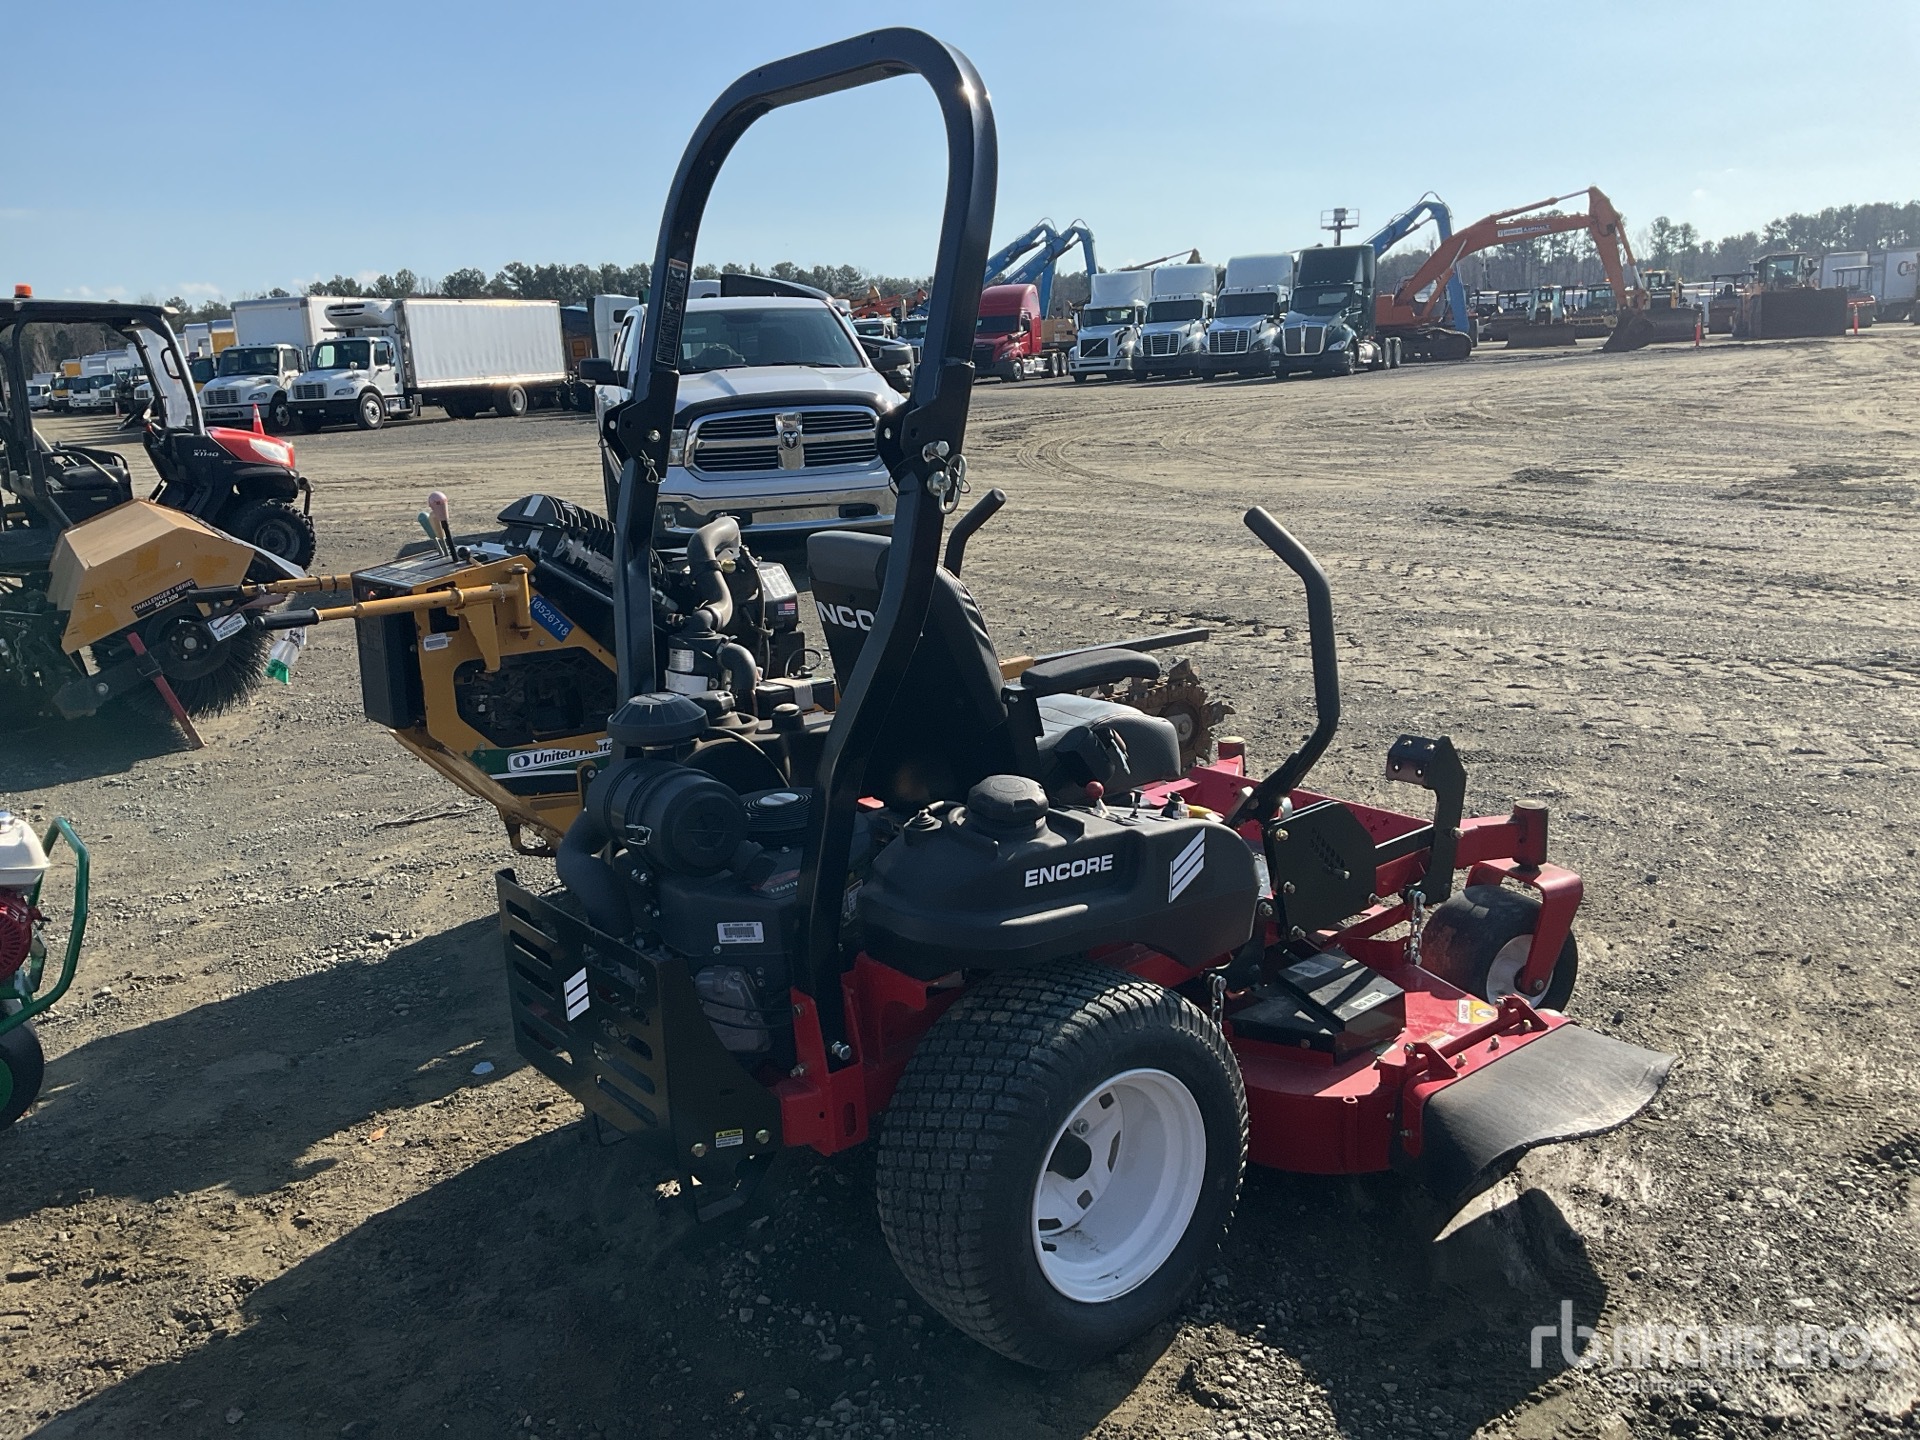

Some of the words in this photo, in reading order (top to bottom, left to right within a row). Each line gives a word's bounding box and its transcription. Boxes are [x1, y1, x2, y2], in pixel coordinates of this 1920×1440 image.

[1897, 261, 1917, 277] CEN
[132, 589, 171, 612] CHALLENGER
[175, 580, 195, 592] SERIES
[154, 598, 168, 609] SCM
[168, 593, 179, 603] 200
[530, 596, 569, 637] 10526718
[815, 600, 876, 631] NCO
[533, 749, 576, 764] United
[1024, 853, 1114, 888] ENCORE
